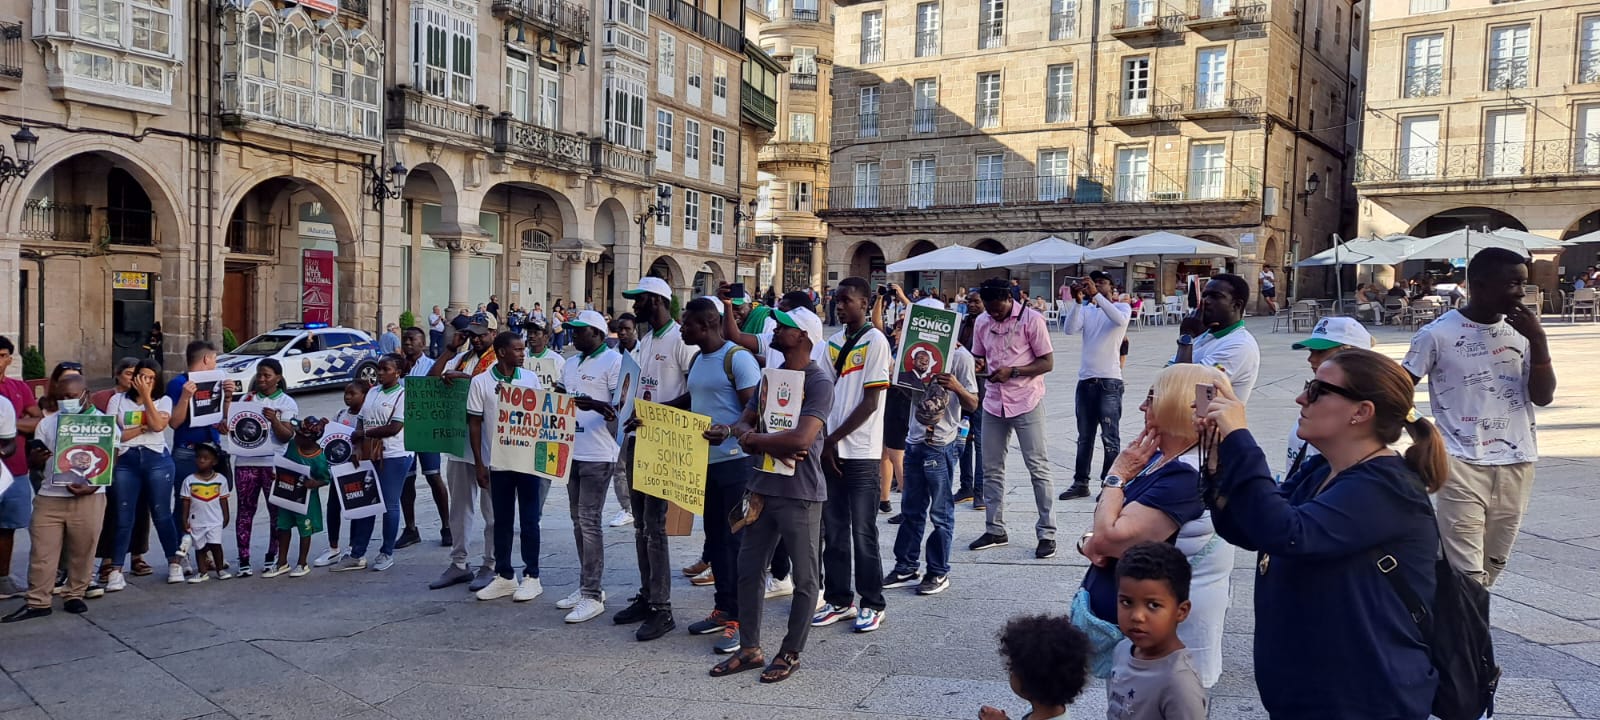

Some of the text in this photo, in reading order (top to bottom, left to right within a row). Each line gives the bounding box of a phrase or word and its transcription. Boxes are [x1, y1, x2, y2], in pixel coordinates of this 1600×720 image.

[912, 317, 951, 333] SONKO
[542, 393, 553, 413] A
[557, 395, 576, 417] LA
[499, 410, 566, 430] DICTADURA
[639, 403, 689, 429] LIBERTAD
[770, 415, 792, 427] Sonko
[60, 425, 112, 434] SONKO
[510, 426, 537, 437] MACKY
[539, 429, 557, 440] SALL
[640, 425, 693, 451] OUSMANE
[658, 449, 693, 466] SONKO
[653, 463, 669, 477] LOS
[689, 471, 701, 488] DE
[674, 488, 703, 507] SENEGAL
